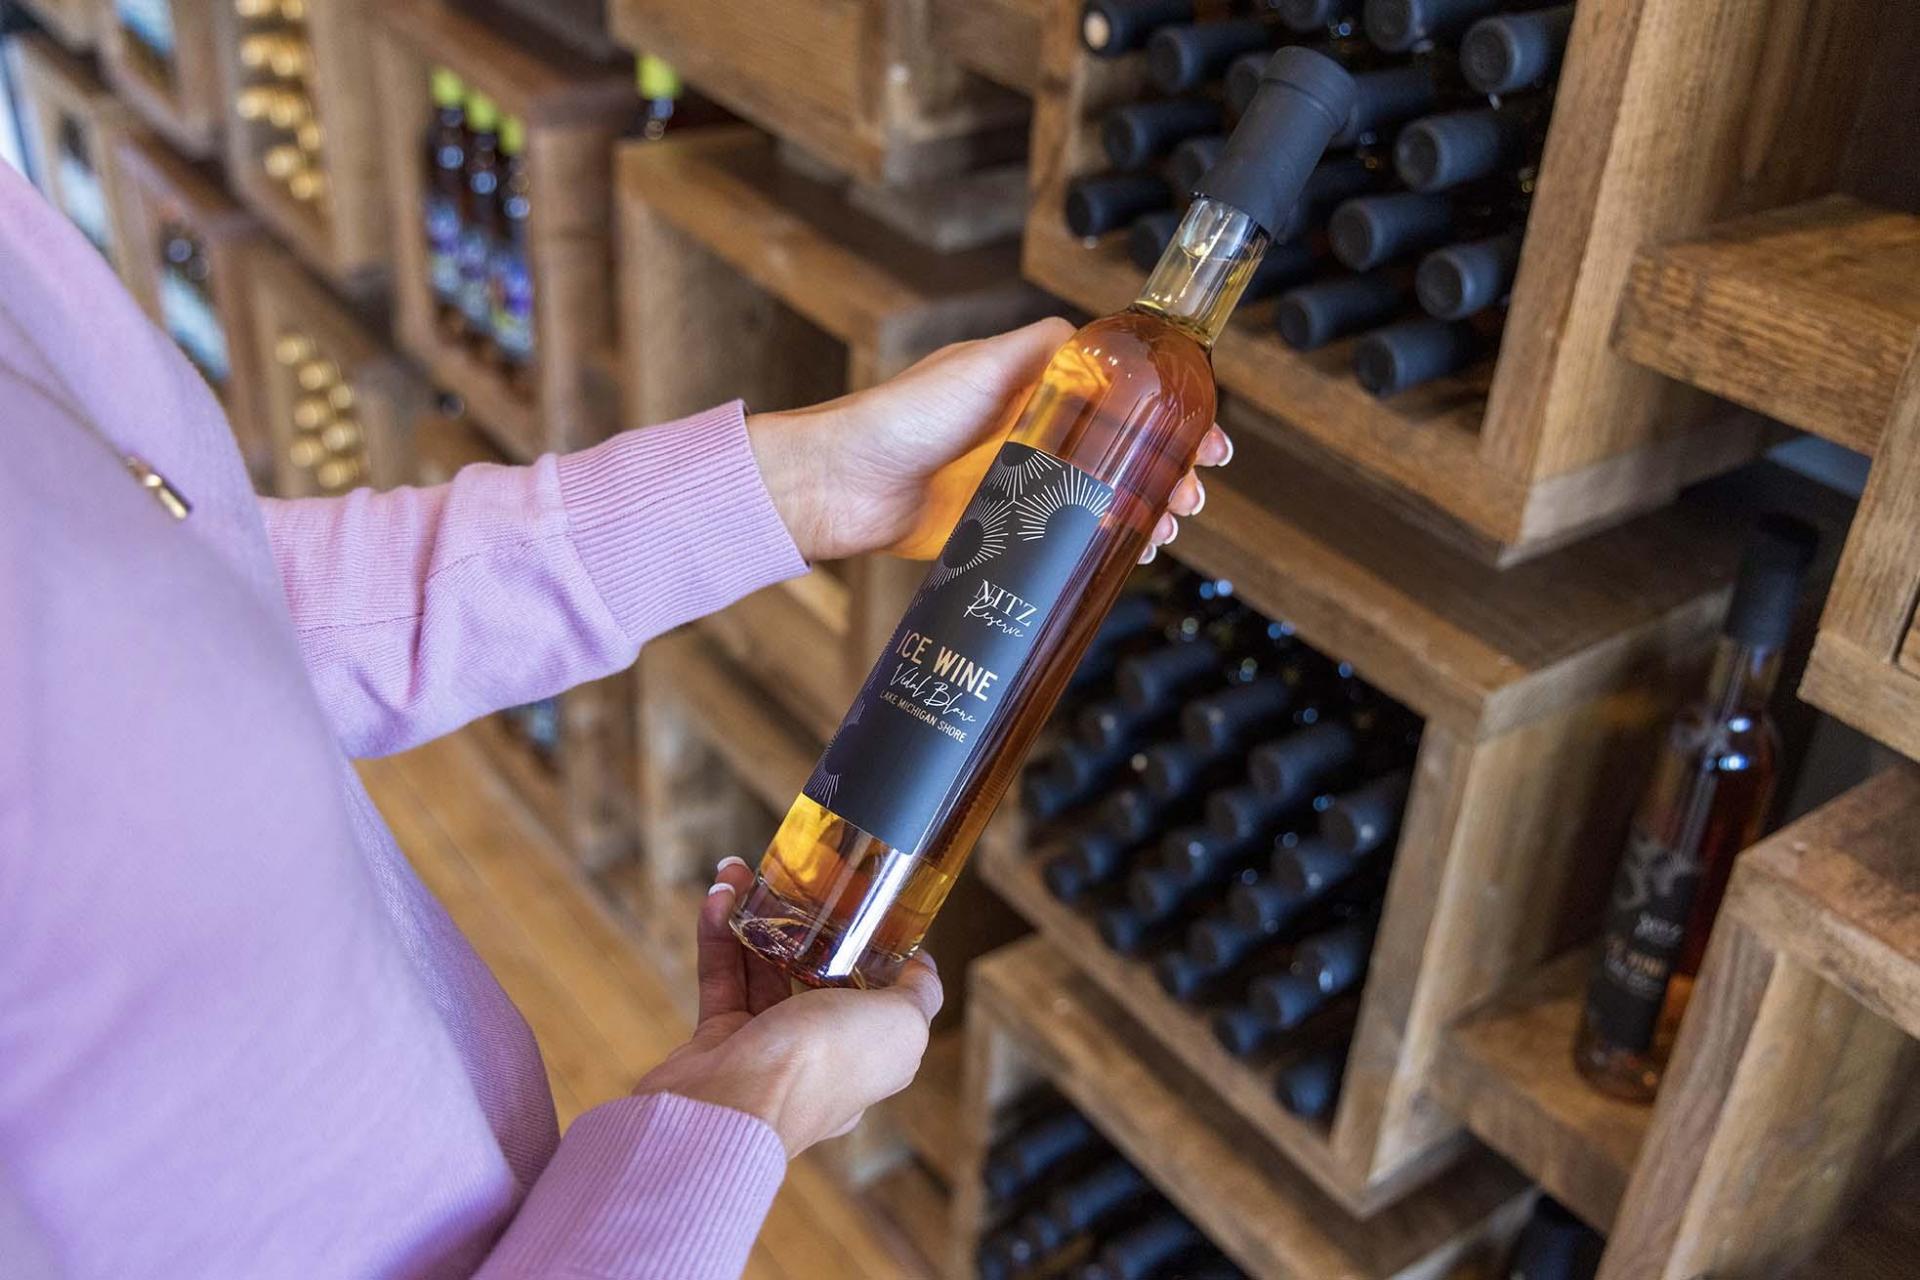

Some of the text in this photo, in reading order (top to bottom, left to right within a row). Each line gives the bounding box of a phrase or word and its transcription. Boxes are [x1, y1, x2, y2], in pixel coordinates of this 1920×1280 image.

[963, 598, 1024, 638] Reserve
[974, 580, 1037, 627] NITZ
[896, 630, 998, 701] ICE WINE
[880, 690, 967, 743] LAKE MICHIGAN SHORE
[890, 663, 976, 722] Vidal Blanc
